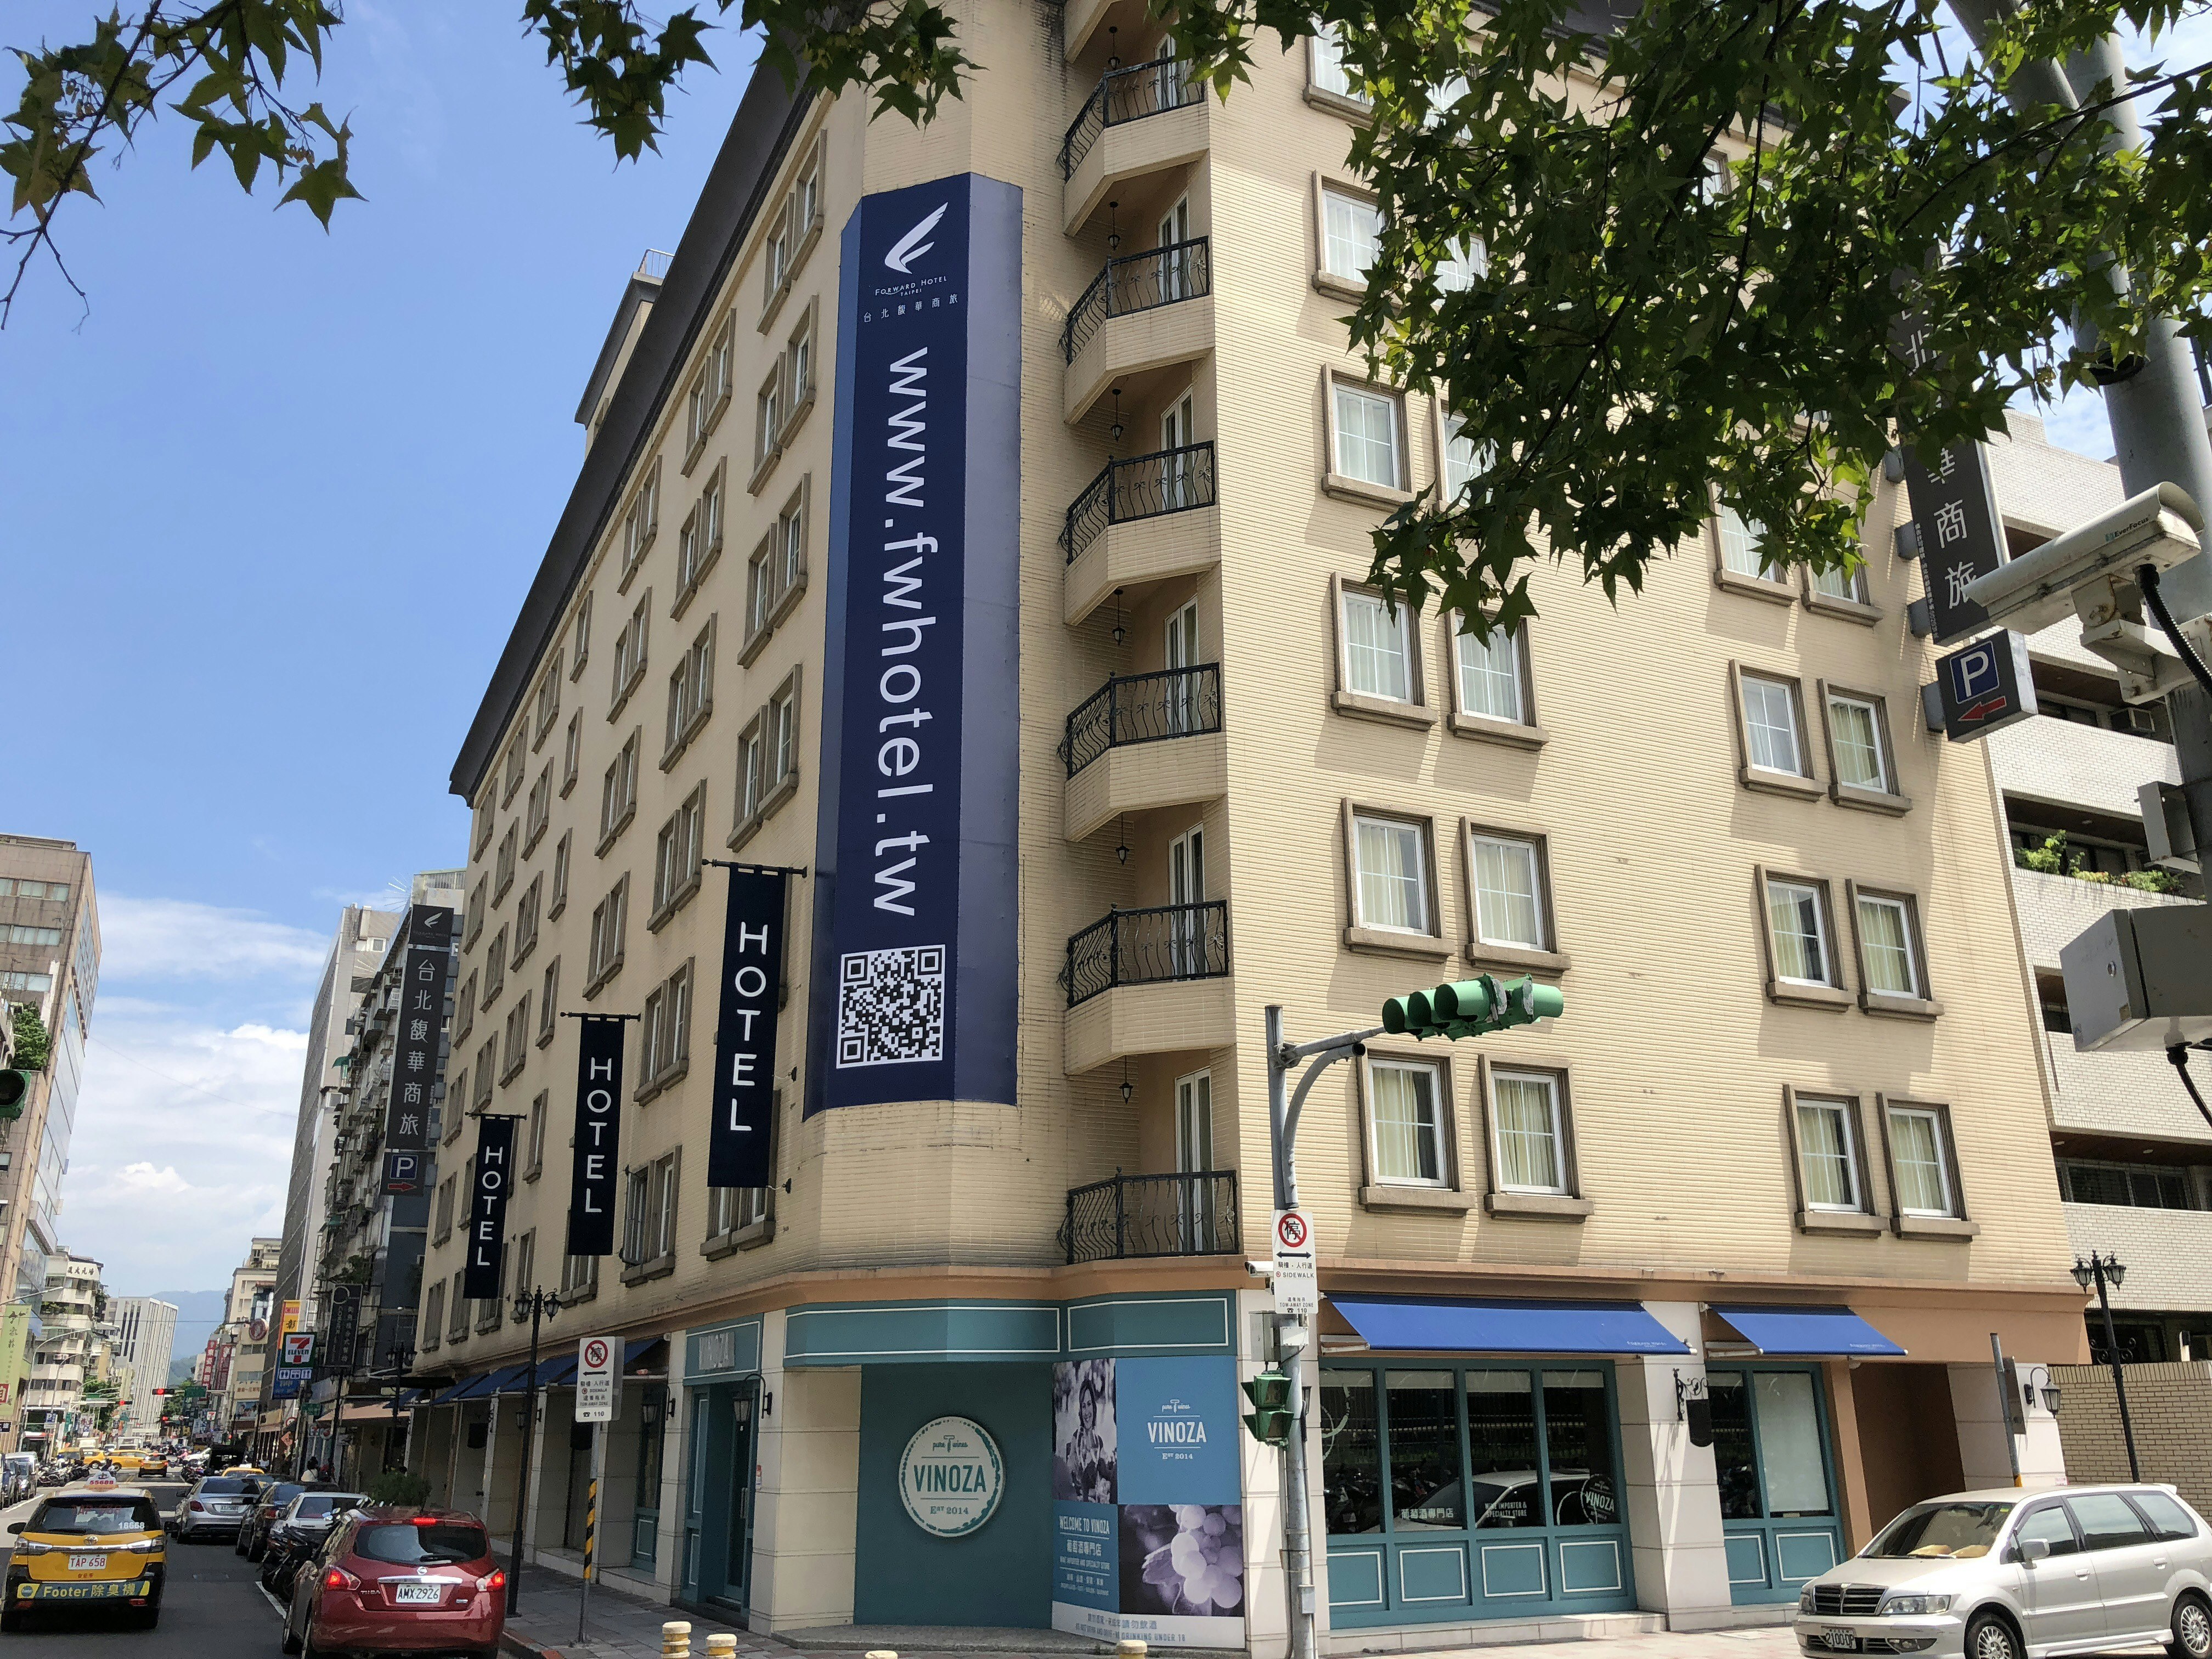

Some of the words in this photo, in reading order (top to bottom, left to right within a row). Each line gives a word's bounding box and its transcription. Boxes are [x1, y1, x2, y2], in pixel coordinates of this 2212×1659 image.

[875, 283, 916, 296] FORWARD
[921, 276, 947, 286] HOTEL
[901, 288, 923, 297] TAIPEI
[864, 294, 958, 323] 台北馥華商旅
[2114, 517, 2149, 537] EverFocus
[873, 346, 938, 916] www.fwhotel.tw
[1960, 651, 1989, 698] P
[730, 921, 768, 1131] HOTEL
[399, 959, 435, 1136] 台北馥華商旅
[585, 1057, 612, 1213] HOTEL
[396, 1157, 414, 1177] P
[477, 1146, 503, 1266] HOTEL
[1284, 1220, 1301, 1240] 停
[290, 1337, 311, 1364] 7
[590, 1346, 603, 1362] 停
[1147, 1421, 1207, 1443] VINOZA
[913, 1464, 987, 1493] VINOZA
[946, 1506, 969, 1515] 2014
[1584, 1491, 1615, 1513] VINOZA
[1059, 1515, 1082, 1532] WELCOME
[1083, 1517, 1090, 1533] TO
[43, 1585, 89, 1598] Footer
